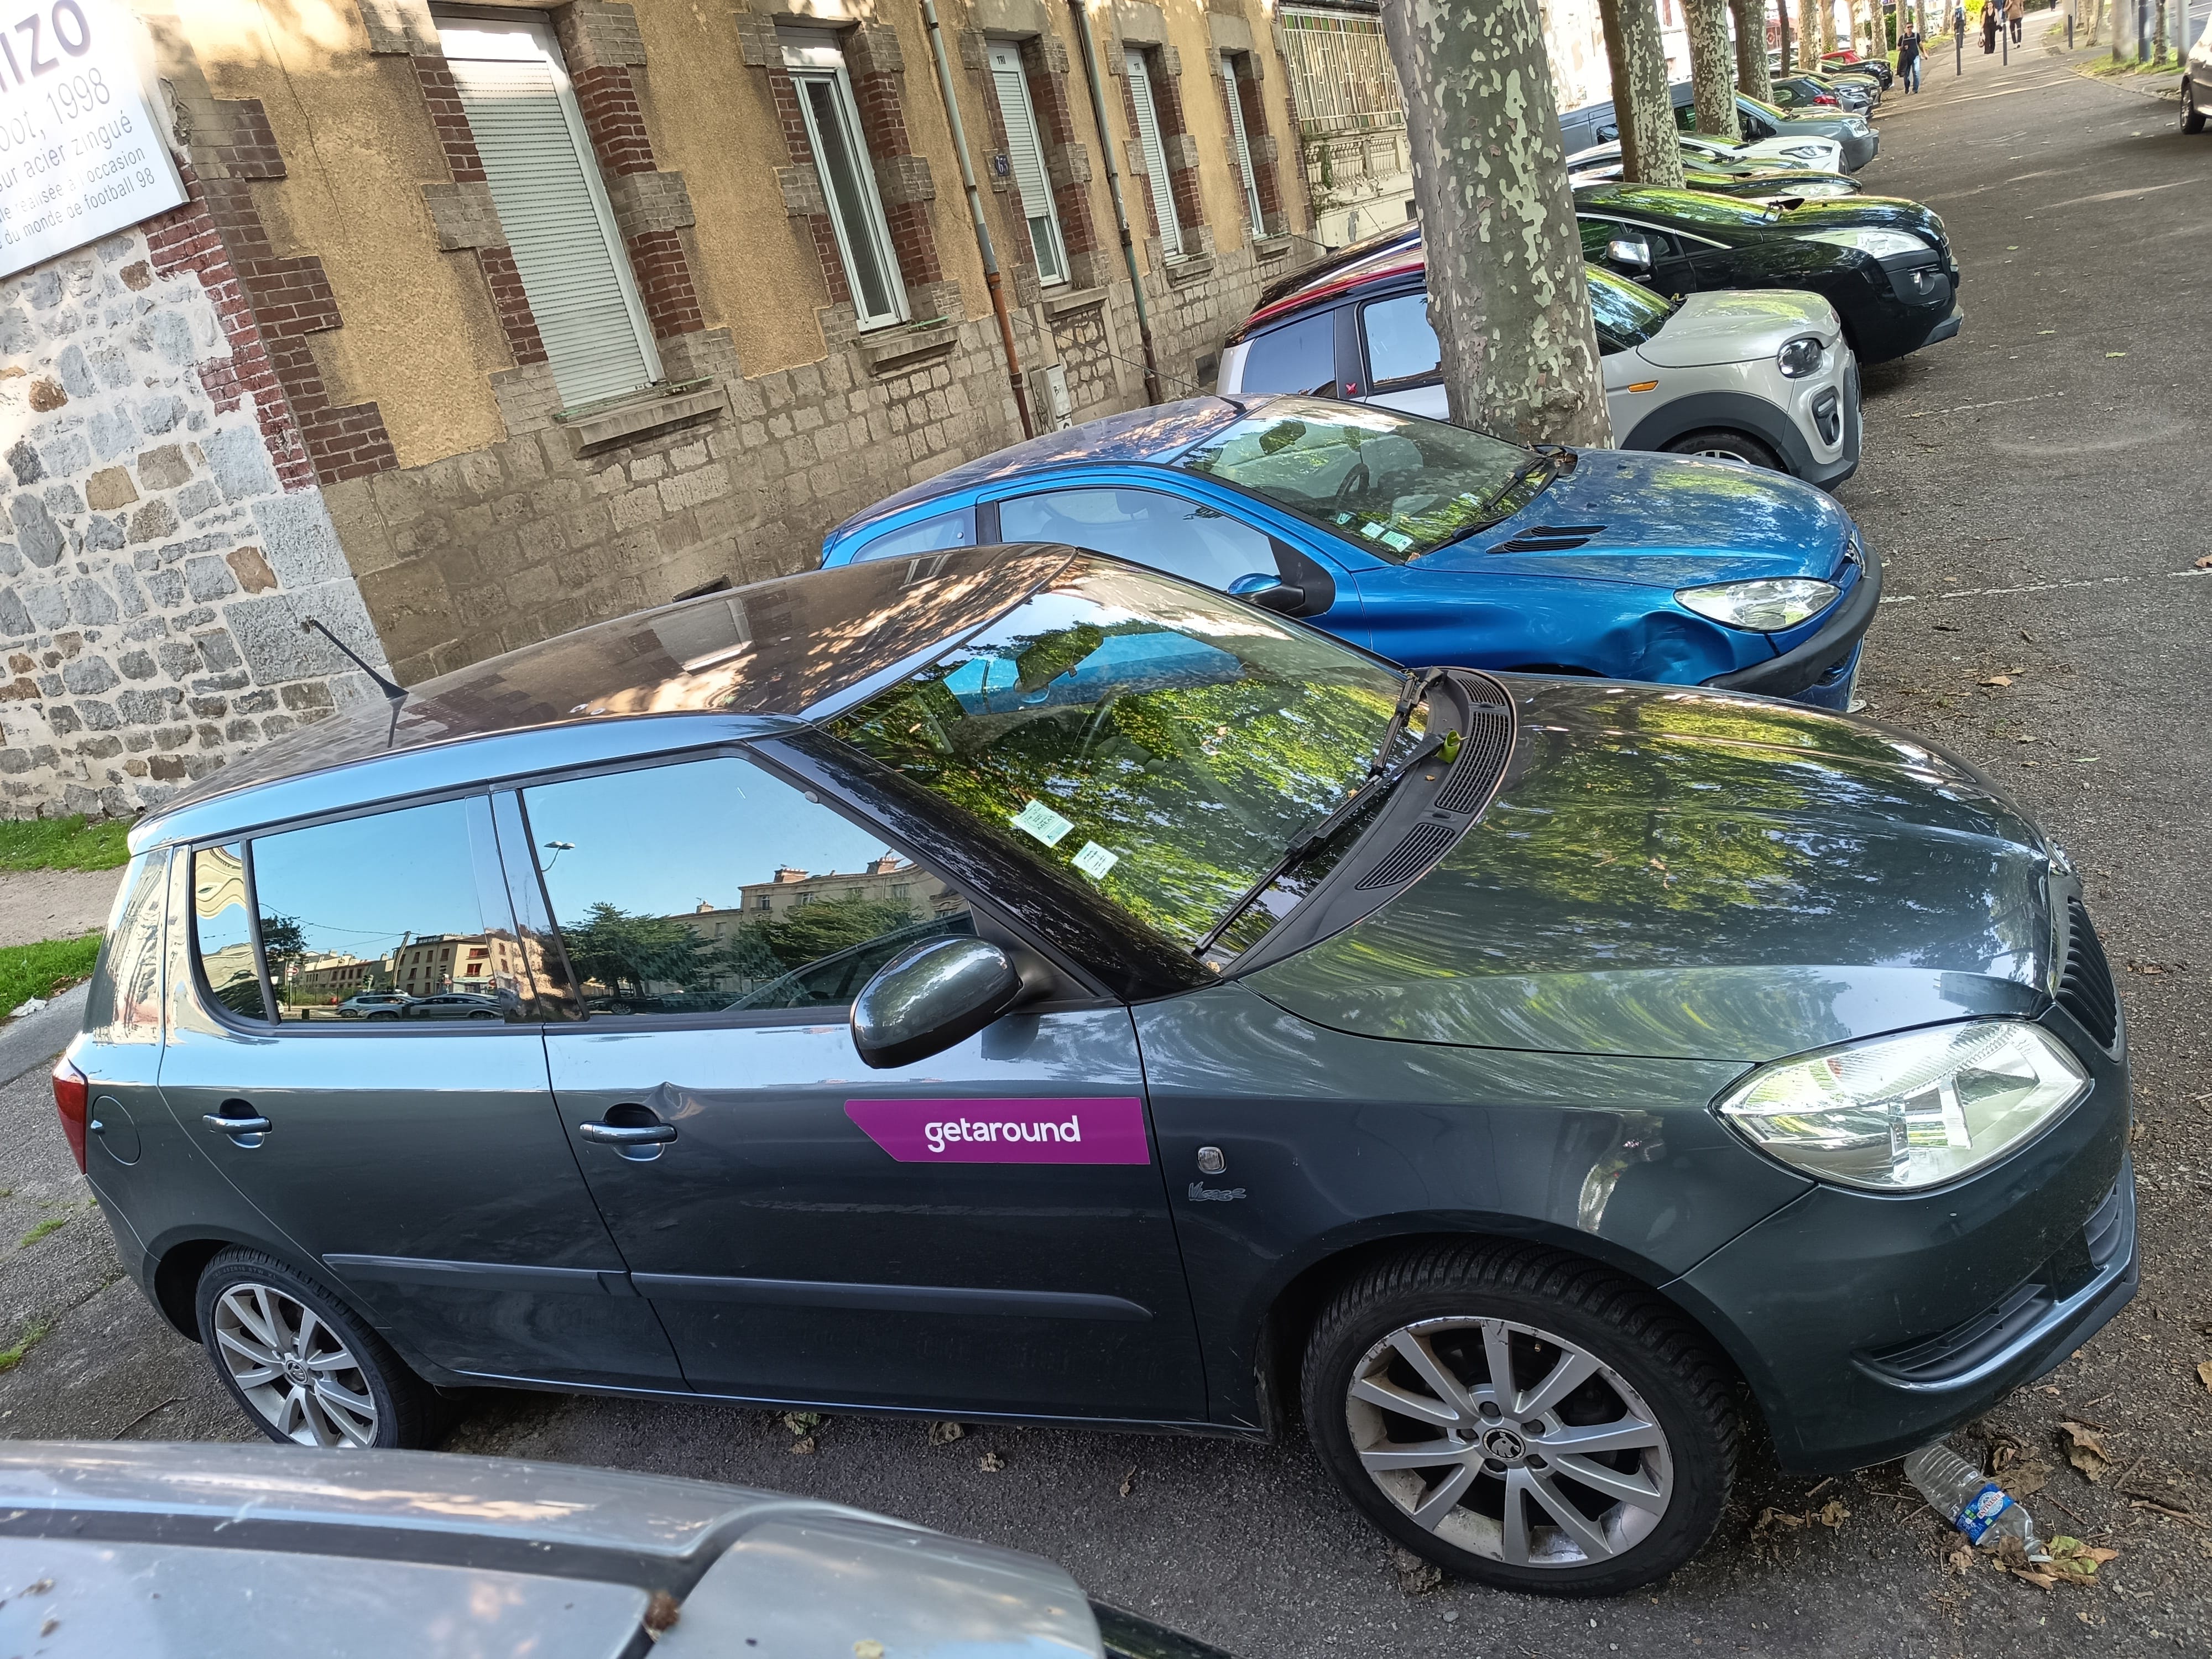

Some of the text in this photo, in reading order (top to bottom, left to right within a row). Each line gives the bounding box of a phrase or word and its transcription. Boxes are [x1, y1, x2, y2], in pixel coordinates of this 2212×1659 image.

[0, 0, 91, 93] IZO
[46, 67, 109, 124] 1998
[0, 109, 133, 192] ur acier zingué
[5, 168, 155, 244] du monde de football 98
[925, 1115, 1081, 1153] getaround
